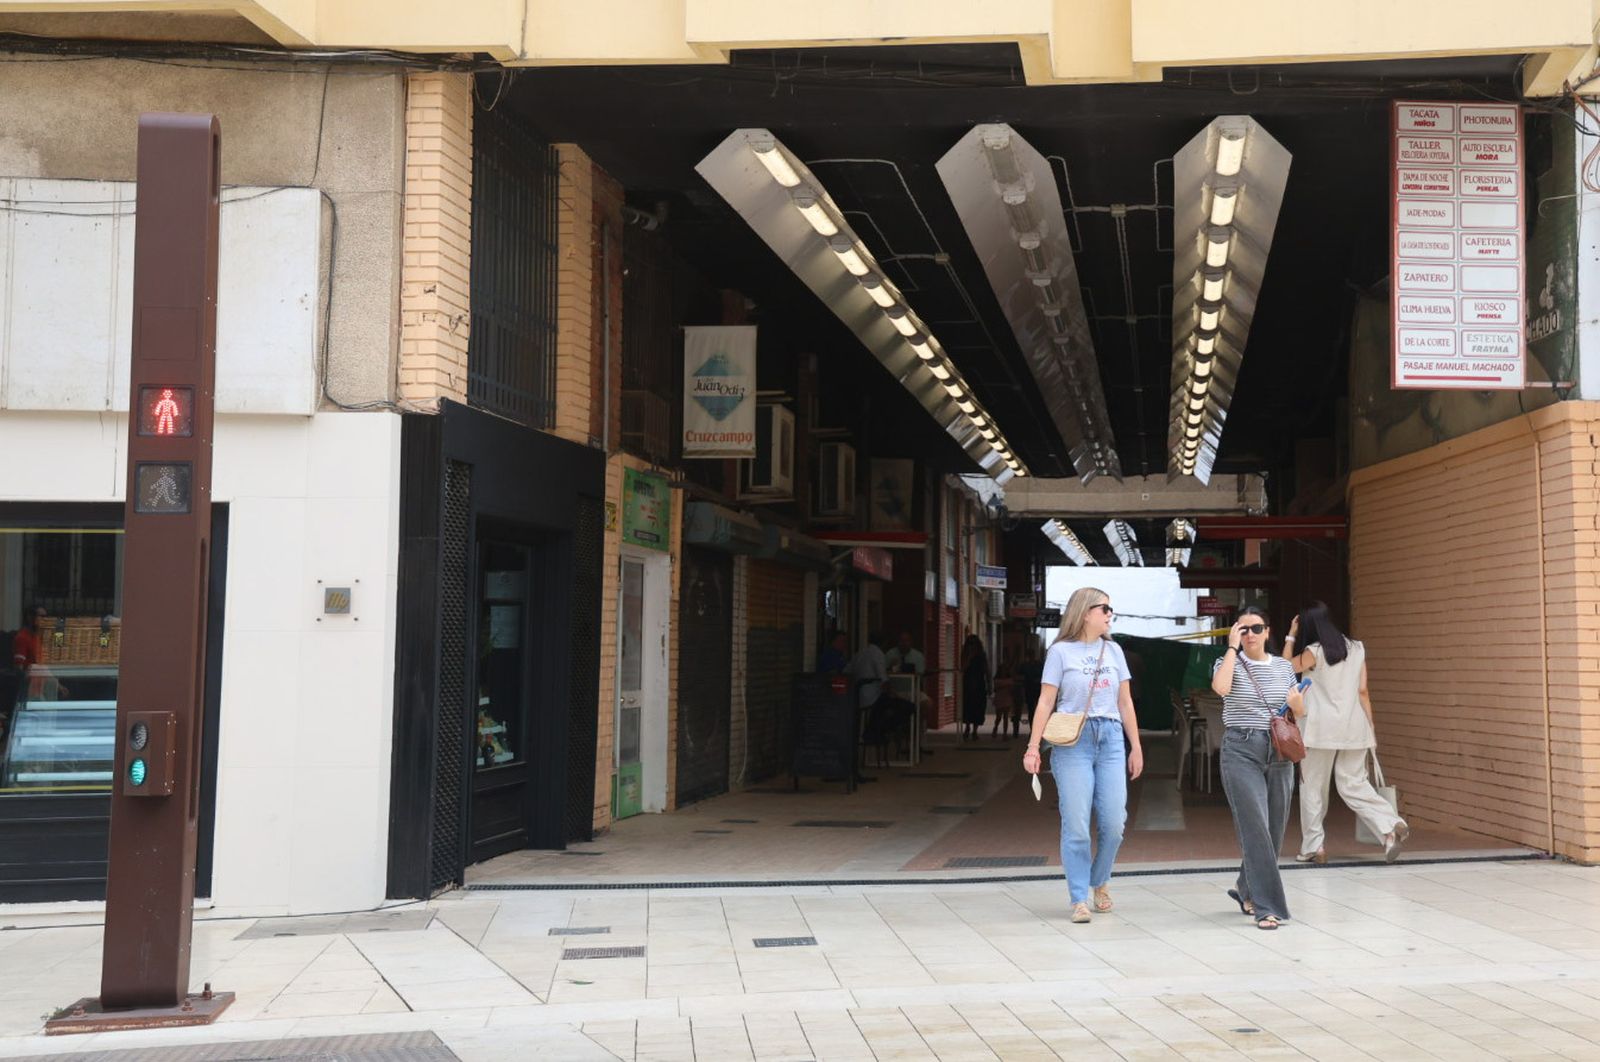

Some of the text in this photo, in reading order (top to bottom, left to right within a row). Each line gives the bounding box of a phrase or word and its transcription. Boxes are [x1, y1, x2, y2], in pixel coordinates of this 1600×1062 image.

[1409, 109, 1440, 119] TACATA
[1408, 141, 1441, 150] TALLER
[1463, 143, 1513, 153] AUTO ESCUELA
[1463, 175, 1513, 185] FLORISTERIA
[1465, 237, 1512, 247] CAFETERIA
[1403, 272, 1449, 282] ZAPATERO
[1400, 304, 1451, 315] CLIMA HUELVA
[1474, 302, 1506, 311] KIOSCO
[1527, 310, 1559, 341] HADO
[1404, 337, 1451, 347] DE LA CORTE
[1466, 333, 1513, 343] ESTETICA
[1471, 345, 1509, 353] FRAYMA
[1403, 361, 1515, 372] PASAJE MANUEL MACHADO
[685, 429, 753, 444] Cruzcampo
